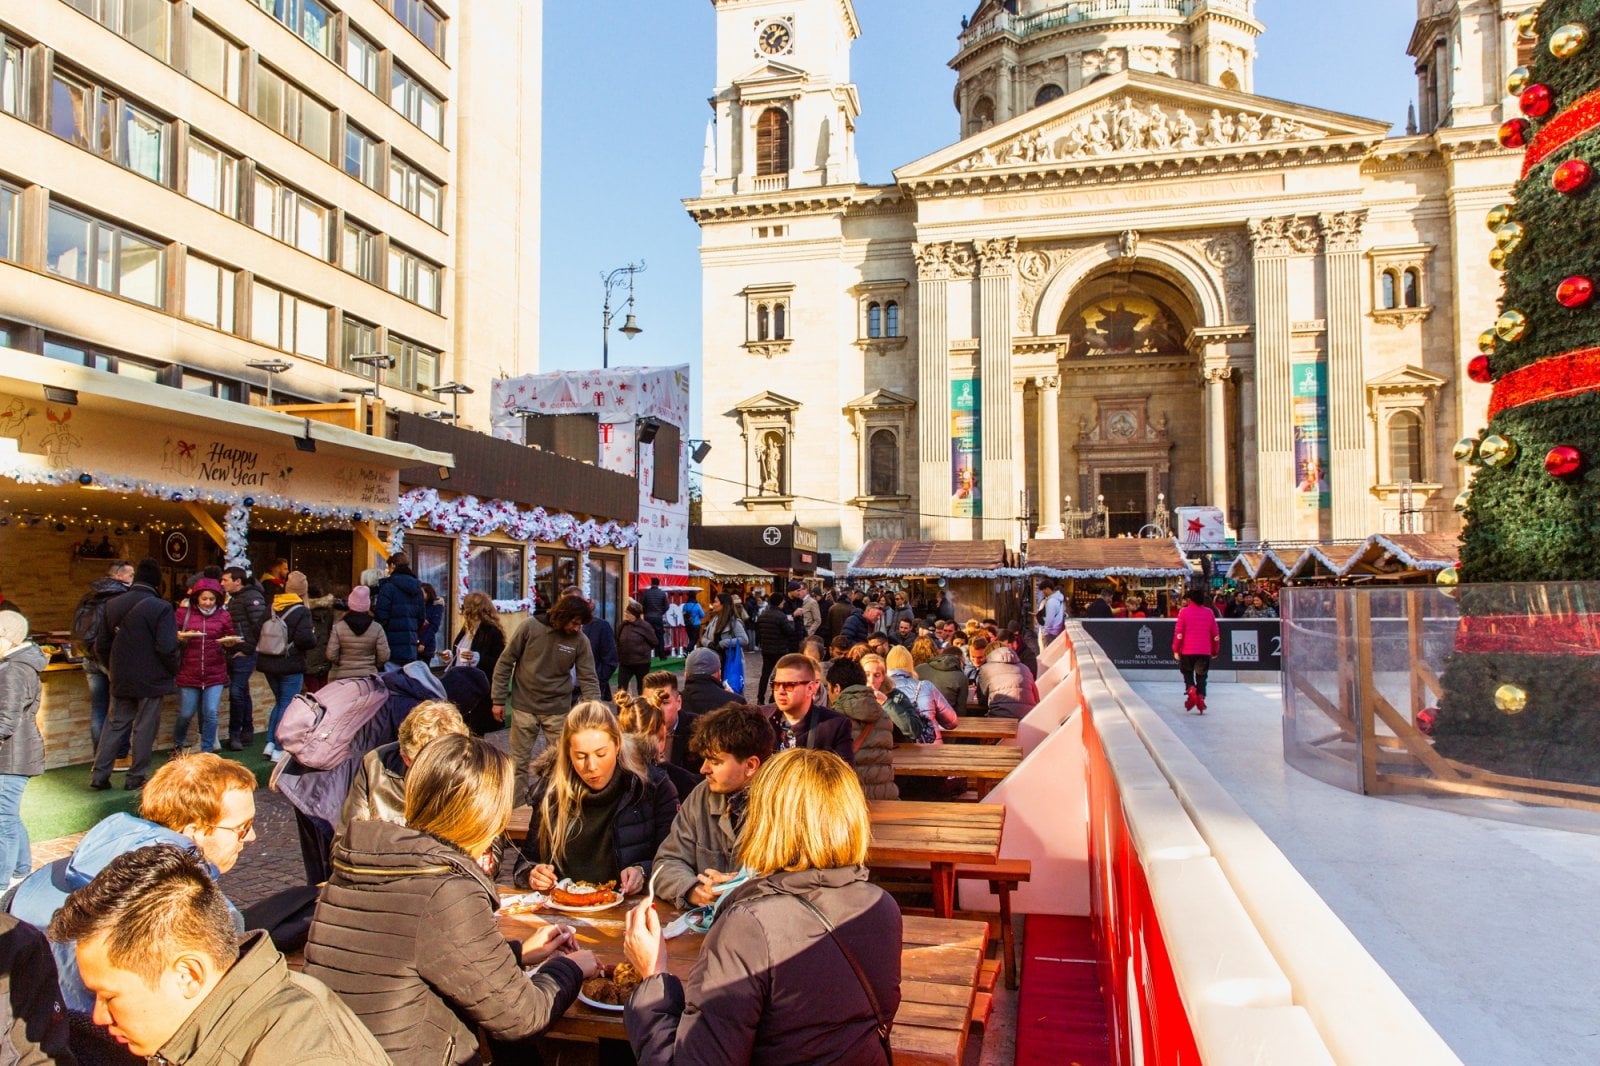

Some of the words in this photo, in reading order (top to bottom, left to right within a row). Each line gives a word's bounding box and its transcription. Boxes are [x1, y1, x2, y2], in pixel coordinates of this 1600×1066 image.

[998, 199, 1029, 213] EGO
[1039, 196, 1073, 209] SUM
[1085, 192, 1113, 206] VIA
[1123, 184, 1189, 202] VERITAS
[1200, 182, 1218, 196] ET
[207, 442, 258, 470] Happy
[199, 462, 230, 481] New
[231, 467, 270, 486] Year
[1234, 642, 1257, 656] MKB
